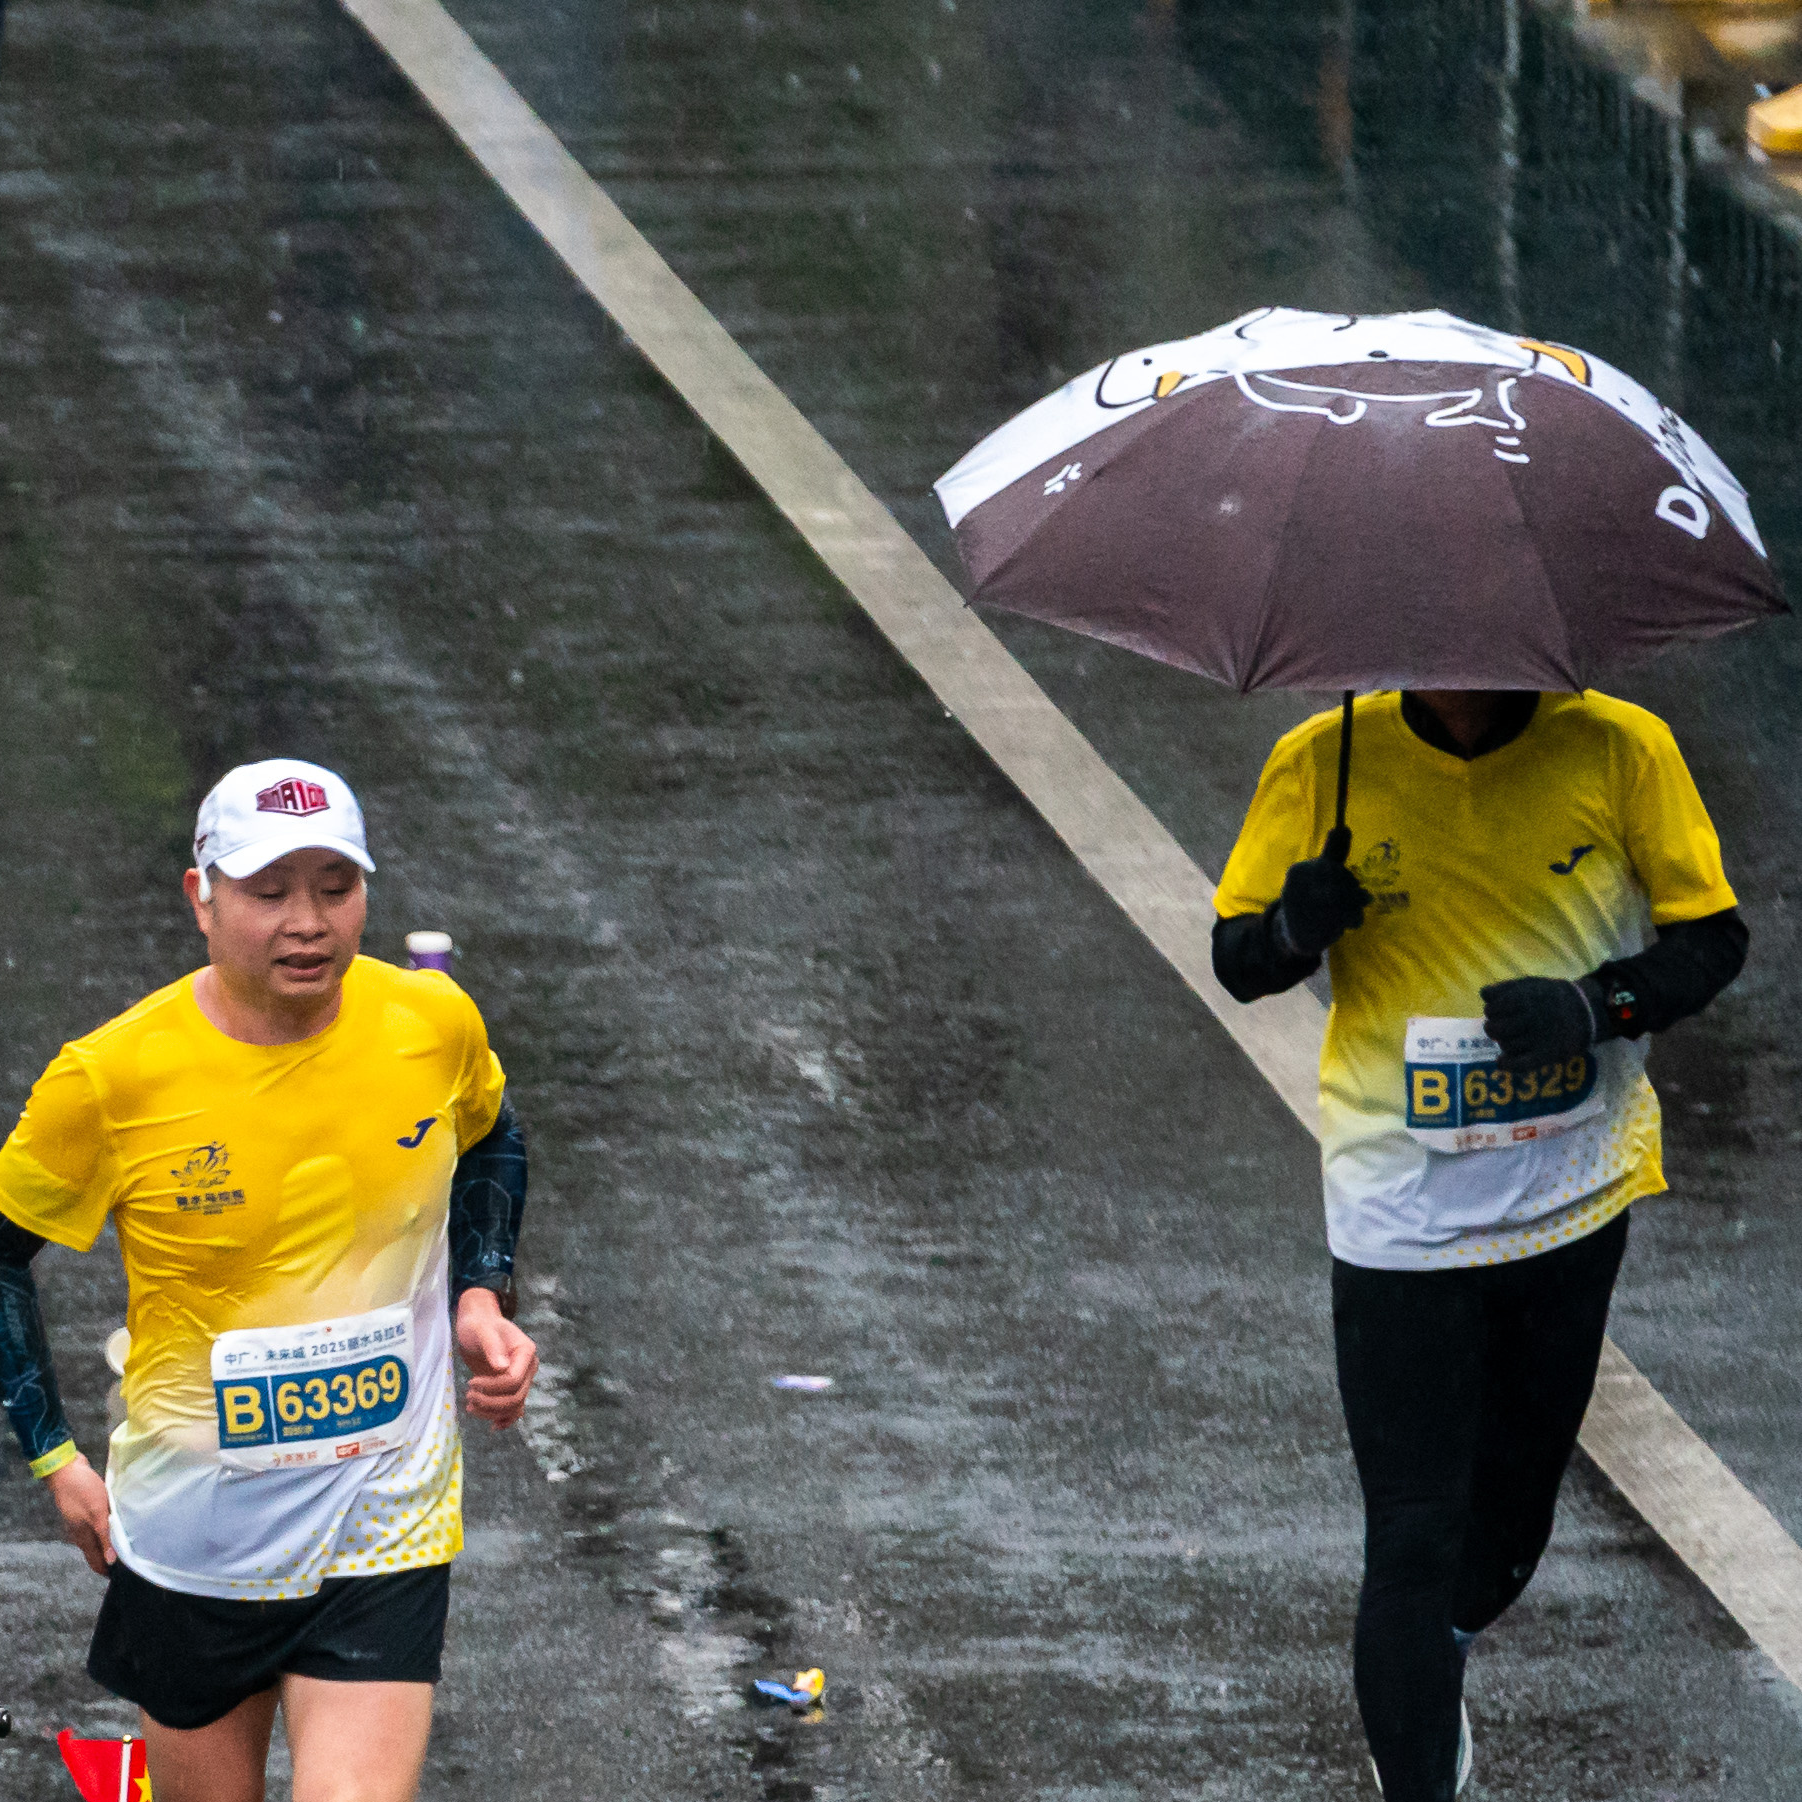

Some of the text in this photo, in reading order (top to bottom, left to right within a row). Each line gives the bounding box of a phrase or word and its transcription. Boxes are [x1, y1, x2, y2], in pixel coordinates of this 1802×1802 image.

[1412, 1069, 1451, 1116] B
[222, 1361, 402, 1435] B 63369
